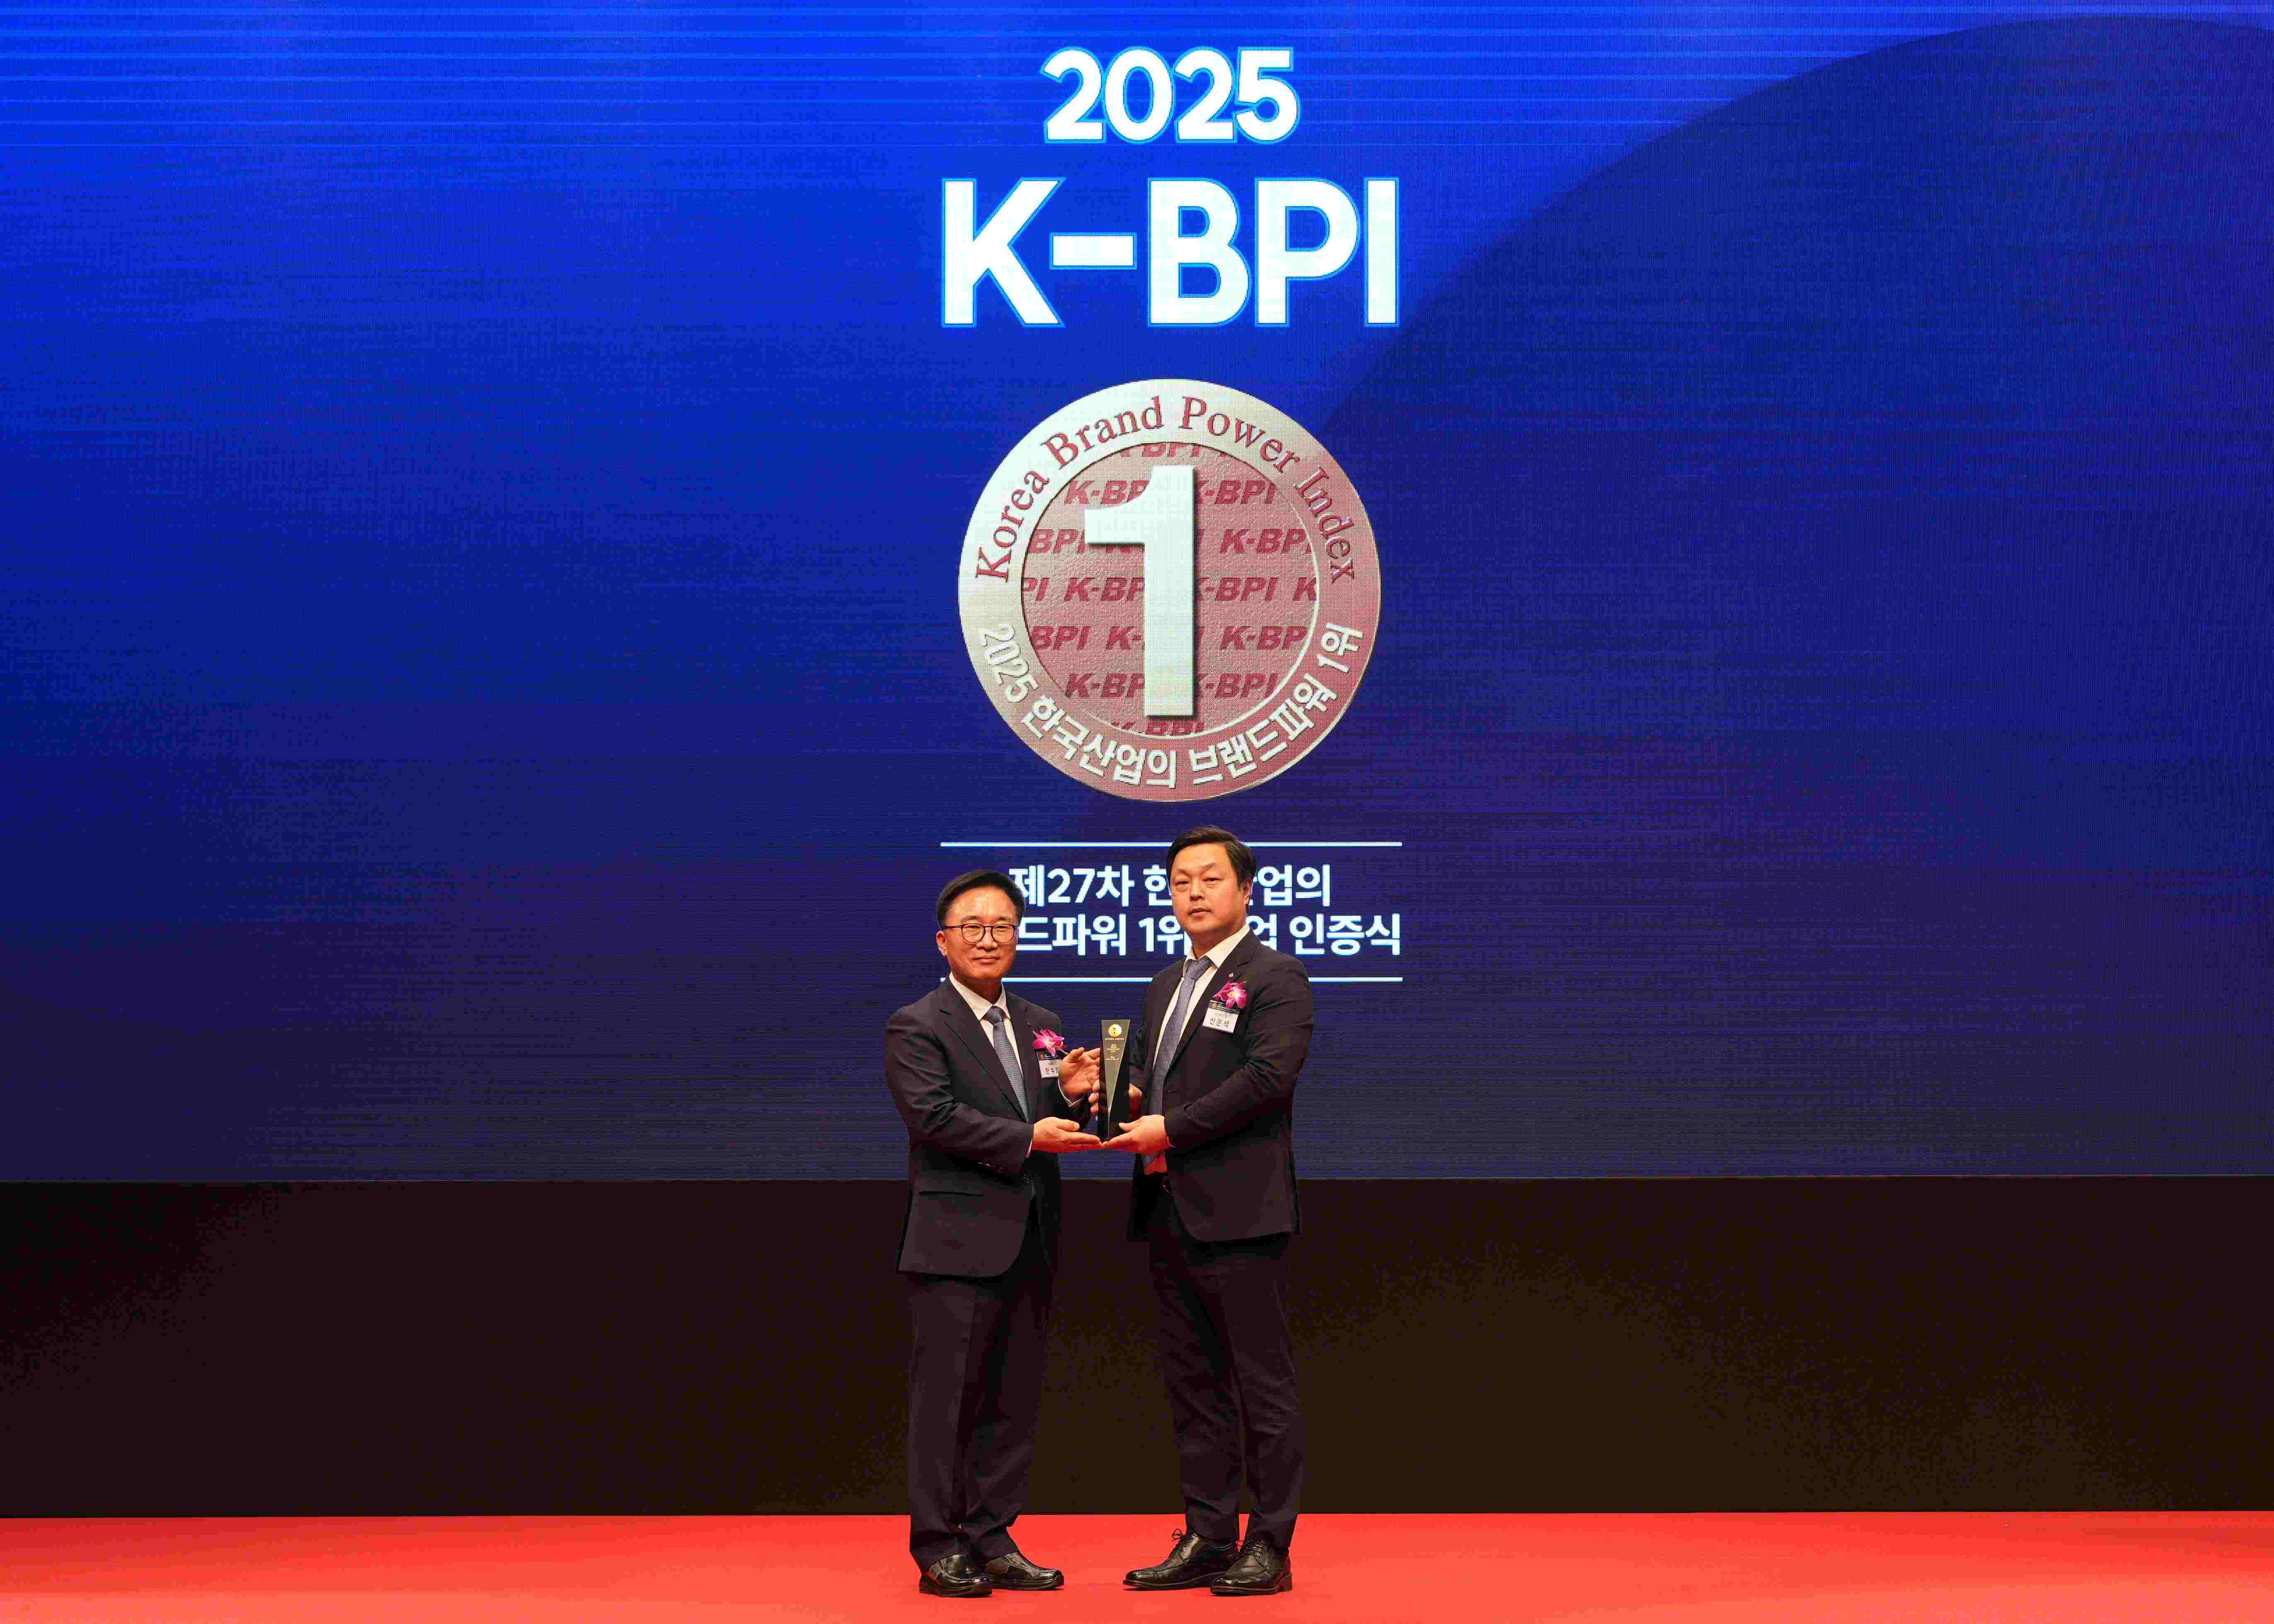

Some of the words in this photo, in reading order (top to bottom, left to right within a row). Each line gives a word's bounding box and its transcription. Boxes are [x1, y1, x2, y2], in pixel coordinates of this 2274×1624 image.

[1040, 46, 1300, 143] 2025
[942, 177, 1399, 327] K-BPI
[975, 470, 1049, 583] Korea
[1040, 396, 1165, 470] Brand
[1178, 396, 1300, 473] Power
[1293, 467, 1355, 583] Index
[1064, 480, 1150, 504] K-BP
[1063, 577, 1145, 601] K-BP
[1197, 577, 1278, 601] -BPI
[1084, 465, 1194, 716] 1
[1220, 626, 1308, 650] K-BP
[980, 622, 1039, 703] 2025
[1022, 696, 1177, 789] 한국산업의
[1189, 673, 1338, 785] 브랜드파워
[1317, 622, 1364, 673] 1위
[1065, 673, 1145, 698] K-BP
[1197, 673, 1280, 698] -BPI
[1009, 864, 1135, 907] 제27차
[1289, 913, 1400, 956] 인증식
